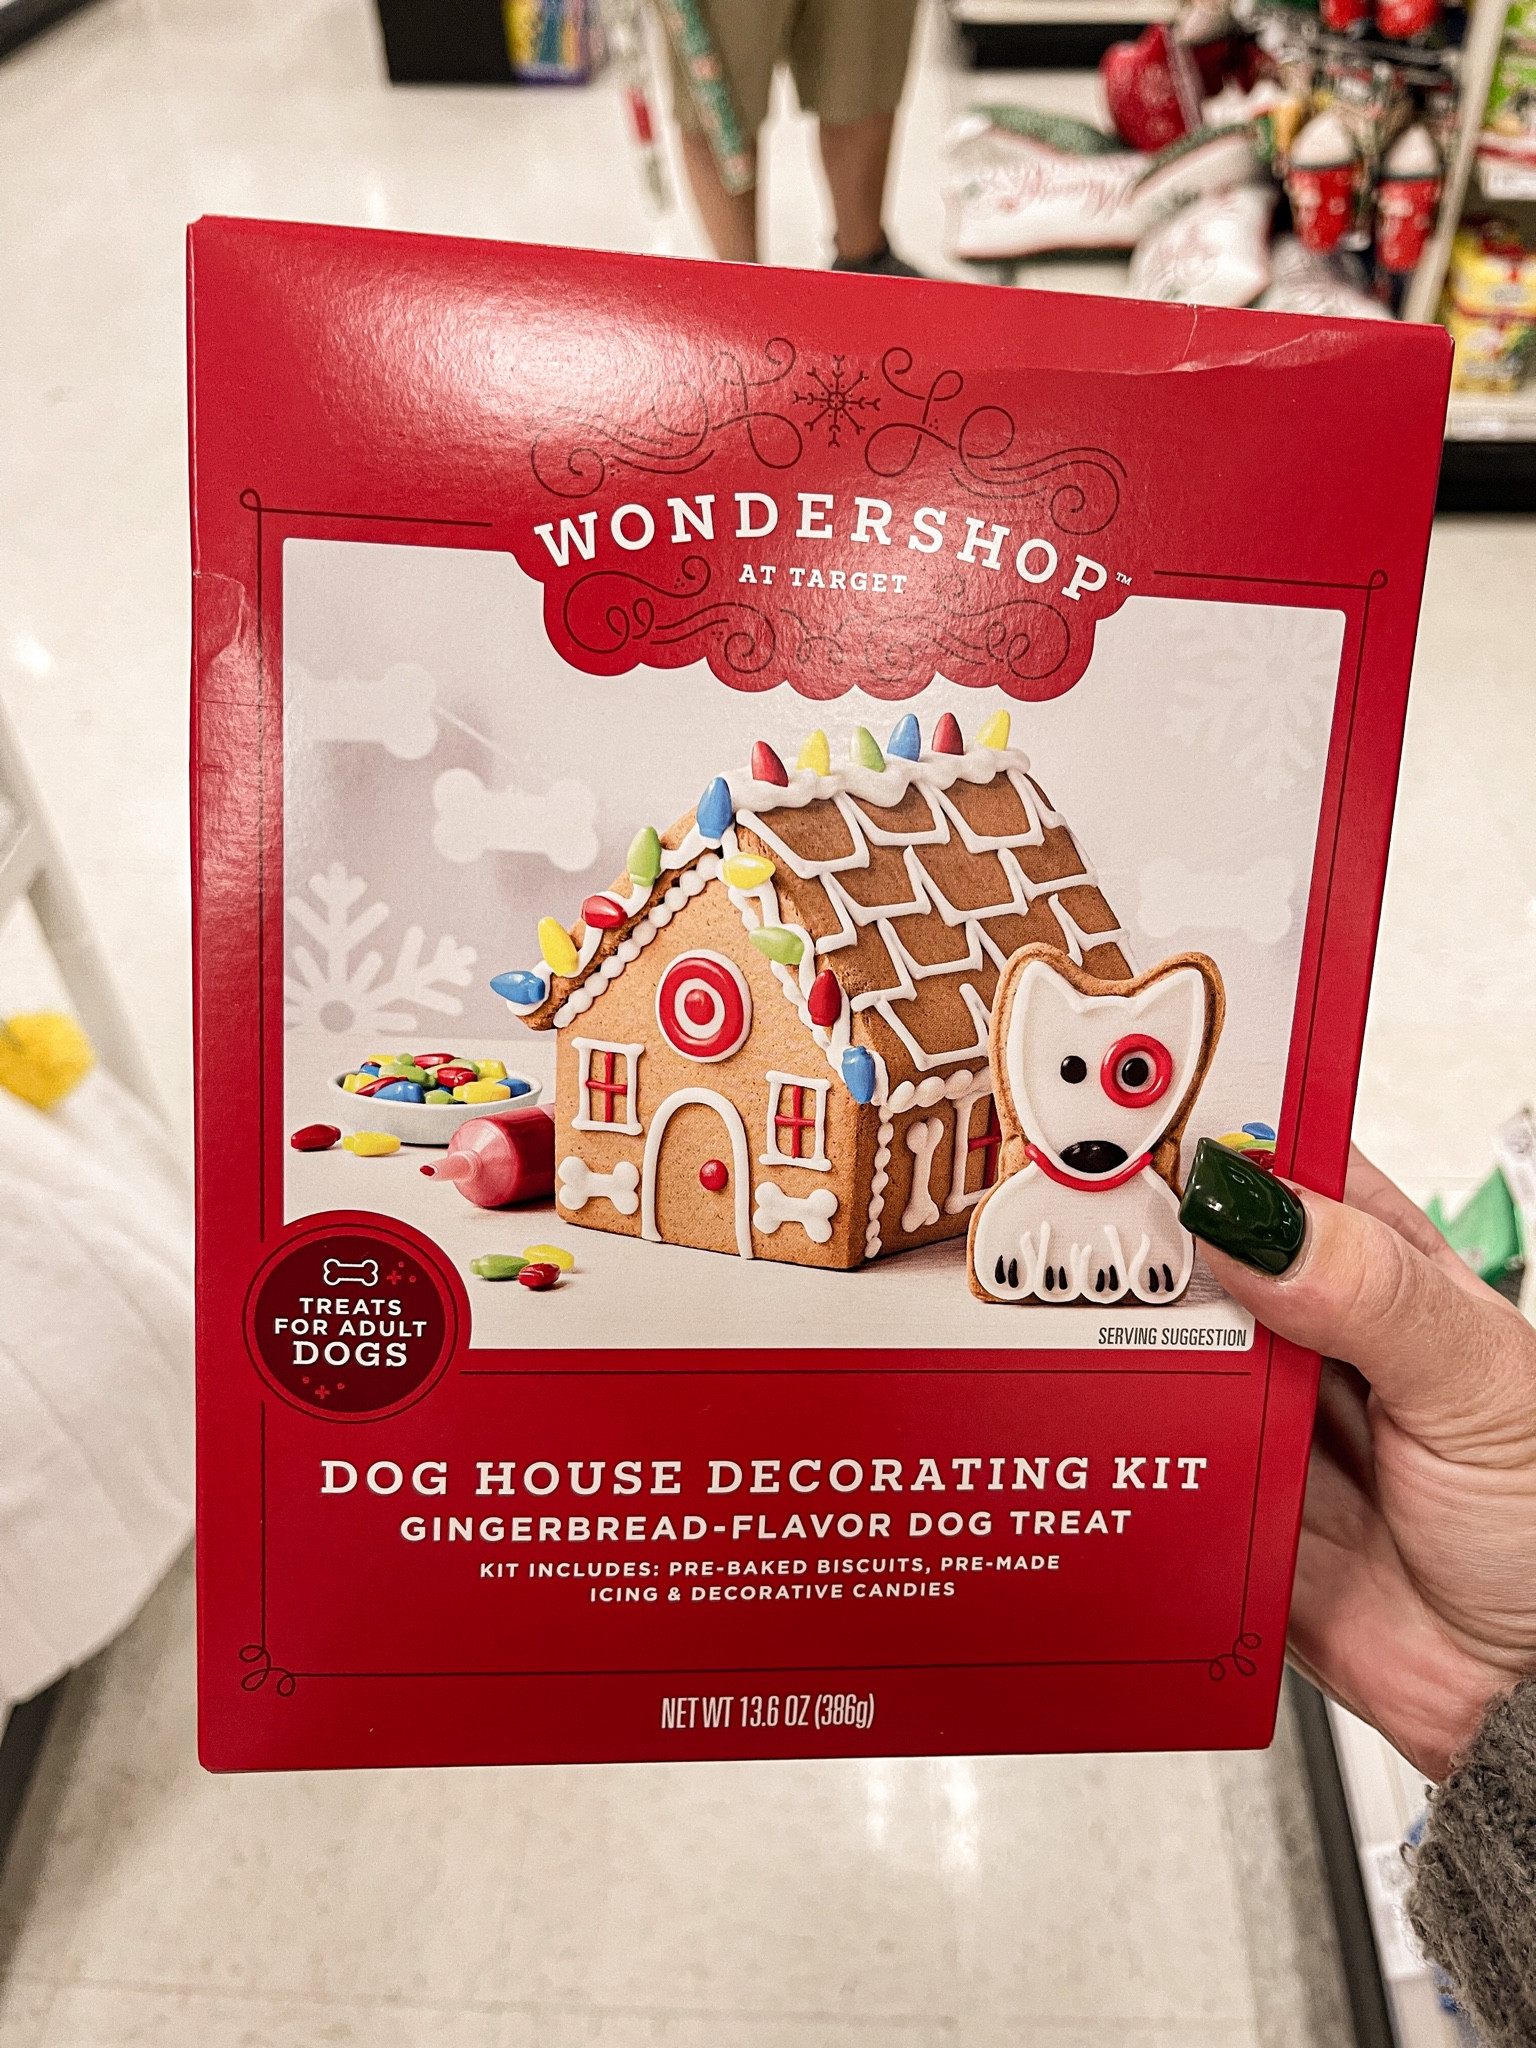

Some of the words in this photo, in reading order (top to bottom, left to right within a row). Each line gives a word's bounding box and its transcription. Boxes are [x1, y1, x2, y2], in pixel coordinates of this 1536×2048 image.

[738, 563, 777, 585] AT
[788, 566, 909, 595] TARGET
[298, 1296, 403, 1317] TREATS
[273, 1316, 329, 1337] FOR
[338, 1318, 428, 1338] ADULT
[1098, 1326, 1158, 1346] SERVING
[1160, 1327, 1247, 1347] SUGGESTION
[292, 1340, 408, 1368] DOGS
[320, 1459, 448, 1496] DOG
[475, 1460, 683, 1496] HOUSE
[706, 1456, 1090, 1495] DECORATING
[1111, 1456, 1208, 1491] KIT
[399, 1513, 892, 1543] GINGERBREAD-FLAVOR
[908, 1511, 993, 1538] DOG
[1009, 1509, 1133, 1536] TREAT
[479, 1562, 519, 1579] KIT
[528, 1561, 660, 1579] INCLUDES:
[668, 1558, 808, 1578] PRE-BAKED
[817, 1556, 932, 1576] BISCUITS,
[940, 1554, 1061, 1573] PRE-MADE
[590, 1586, 659, 1604] ICING
[667, 1585, 682, 1603] &
[690, 1583, 844, 1602] DECORATIVE
[852, 1581, 956, 1599] CANDIES
[660, 1697, 700, 1730] NET
[702, 1696, 735, 1729] WT
[738, 1695, 780, 1729] 13.6
[784, 1694, 811, 1727] OZ
[813, 1692, 875, 1731] (386g)
